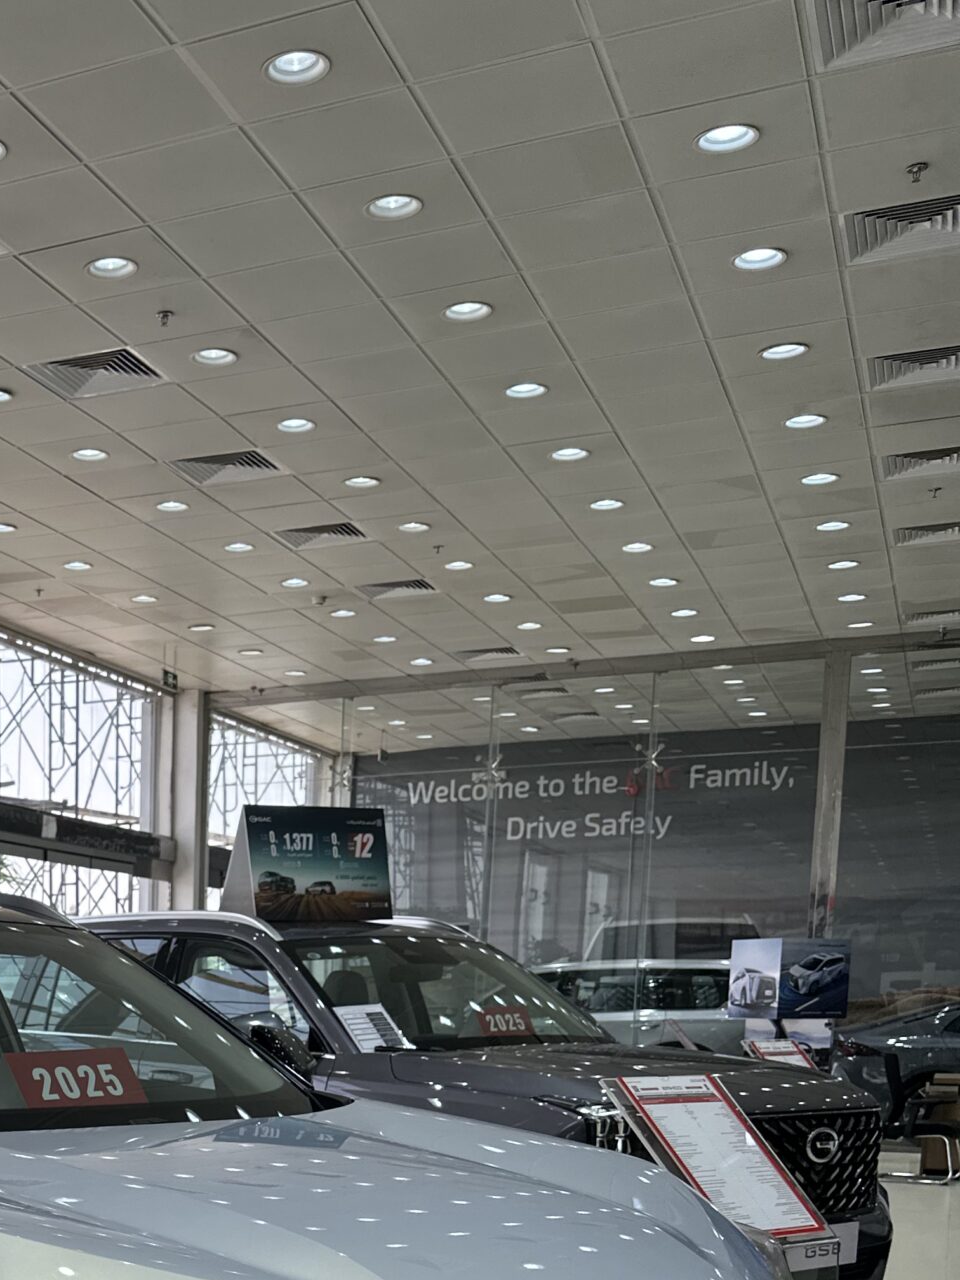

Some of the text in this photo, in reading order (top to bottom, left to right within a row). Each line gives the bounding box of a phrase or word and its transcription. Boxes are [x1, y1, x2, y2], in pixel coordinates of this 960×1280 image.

[408, 779, 530, 805] Welcome
[537, 775, 565, 797] to
[572, 770, 618, 795] the
[689, 761, 794, 791] Family,
[506, 816, 576, 840] Drive
[283, 833, 313, 852] 1,377
[353, 833, 374, 858] 12
[485, 1012, 526, 1033] 2025
[32, 1064, 124, 1100] 2025
